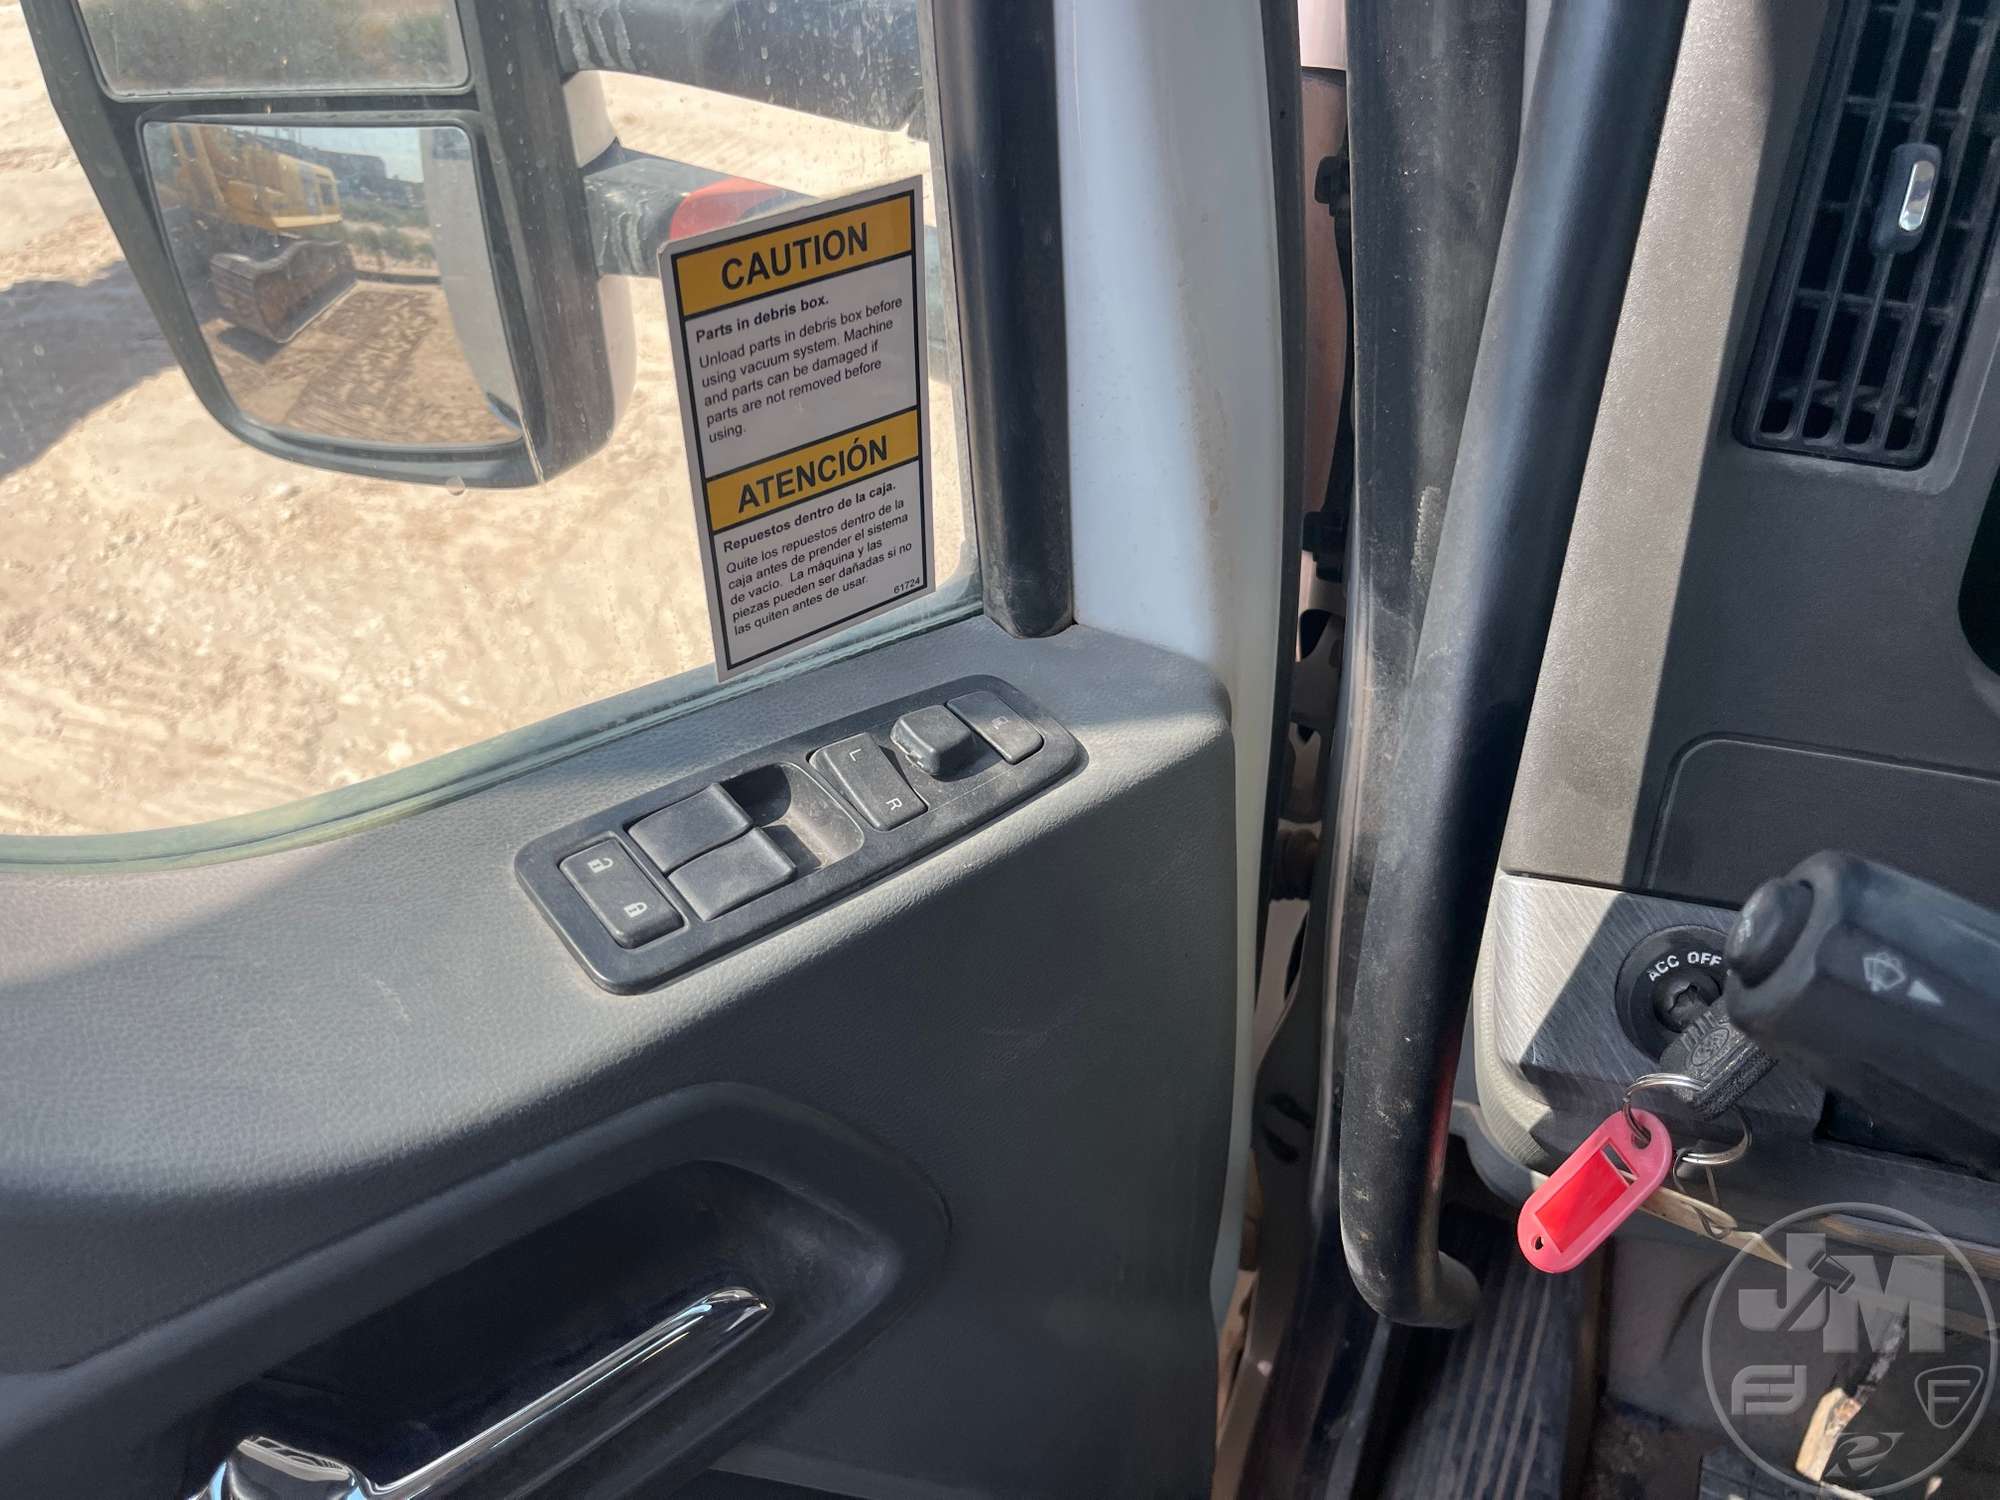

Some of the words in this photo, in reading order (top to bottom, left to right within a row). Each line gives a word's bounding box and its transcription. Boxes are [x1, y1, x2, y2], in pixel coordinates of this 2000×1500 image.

[722, 222, 868, 290] CAUTION
[696, 323, 732, 342] Parts
[737, 319, 749, 331] in
[754, 304, 796, 326] debris
[801, 295, 829, 311] box.
[699, 344, 745, 368] Unload
[750, 335, 781, 355] parts
[784, 330, 795, 343] in
[800, 316, 837, 338] debris
[841, 309, 862, 325] box
[866, 298, 903, 316] before
[702, 369, 737, 388] using
[740, 353, 789, 375] vacuum
[793, 338, 839, 359] system.
[844, 319, 893, 343] Machine
[704, 389, 728, 407] and
[732, 380, 763, 400] parts
[768, 371, 789, 386] can
[794, 363, 809, 377] be
[812, 346, 867, 371] damaged
[871, 339, 879, 353] if
[707, 407, 738, 427] parts
[742, 400, 762, 413] are
[766, 390, 785, 405] not
[789, 369, 841, 398] removed
[845, 360, 882, 378] before
[709, 424, 746, 443] using.
[738, 435, 887, 513] ATENCIÓN
[723, 522, 791, 553] Repuestos
[794, 506, 834, 526] dentro
[838, 498, 852, 510] de
[856, 492, 865, 502] la
[870, 484, 896, 499] caja.
[726, 555, 758, 574] Quite
[762, 548, 778, 560] los
[782, 527, 837, 554] repuestos
[841, 511, 875, 531] dentro
[879, 505, 893, 517] de
[895, 499, 904, 509] la
[728, 574, 752, 590] caja
[756, 562, 788, 580] antes
[791, 554, 805, 566] de
[809, 537, 852, 560] prender
[855, 529, 864, 540] el
[867, 514, 909, 536] sistema
[730, 594, 745, 605] de
[790, 569, 804, 582] La
[858, 546, 864, 558] y
[867, 538, 882, 553] las
[732, 601, 770, 622] piezas
[773, 582, 815, 608] pueden
[819, 574, 835, 586] ser
[888, 547, 896, 559] si
[899, 543, 912, 553] no
[894, 577, 920, 594] 61724
[735, 625, 752, 635] las
[754, 608, 789, 628] quiten
[792, 595, 822, 613] antes
[826, 587, 839, 599] de
[850, 749, 861, 761] L
[886, 797, 902, 810] R
[1647, 955, 1679, 981] ACC
[1687, 952, 1721, 966] OFF
